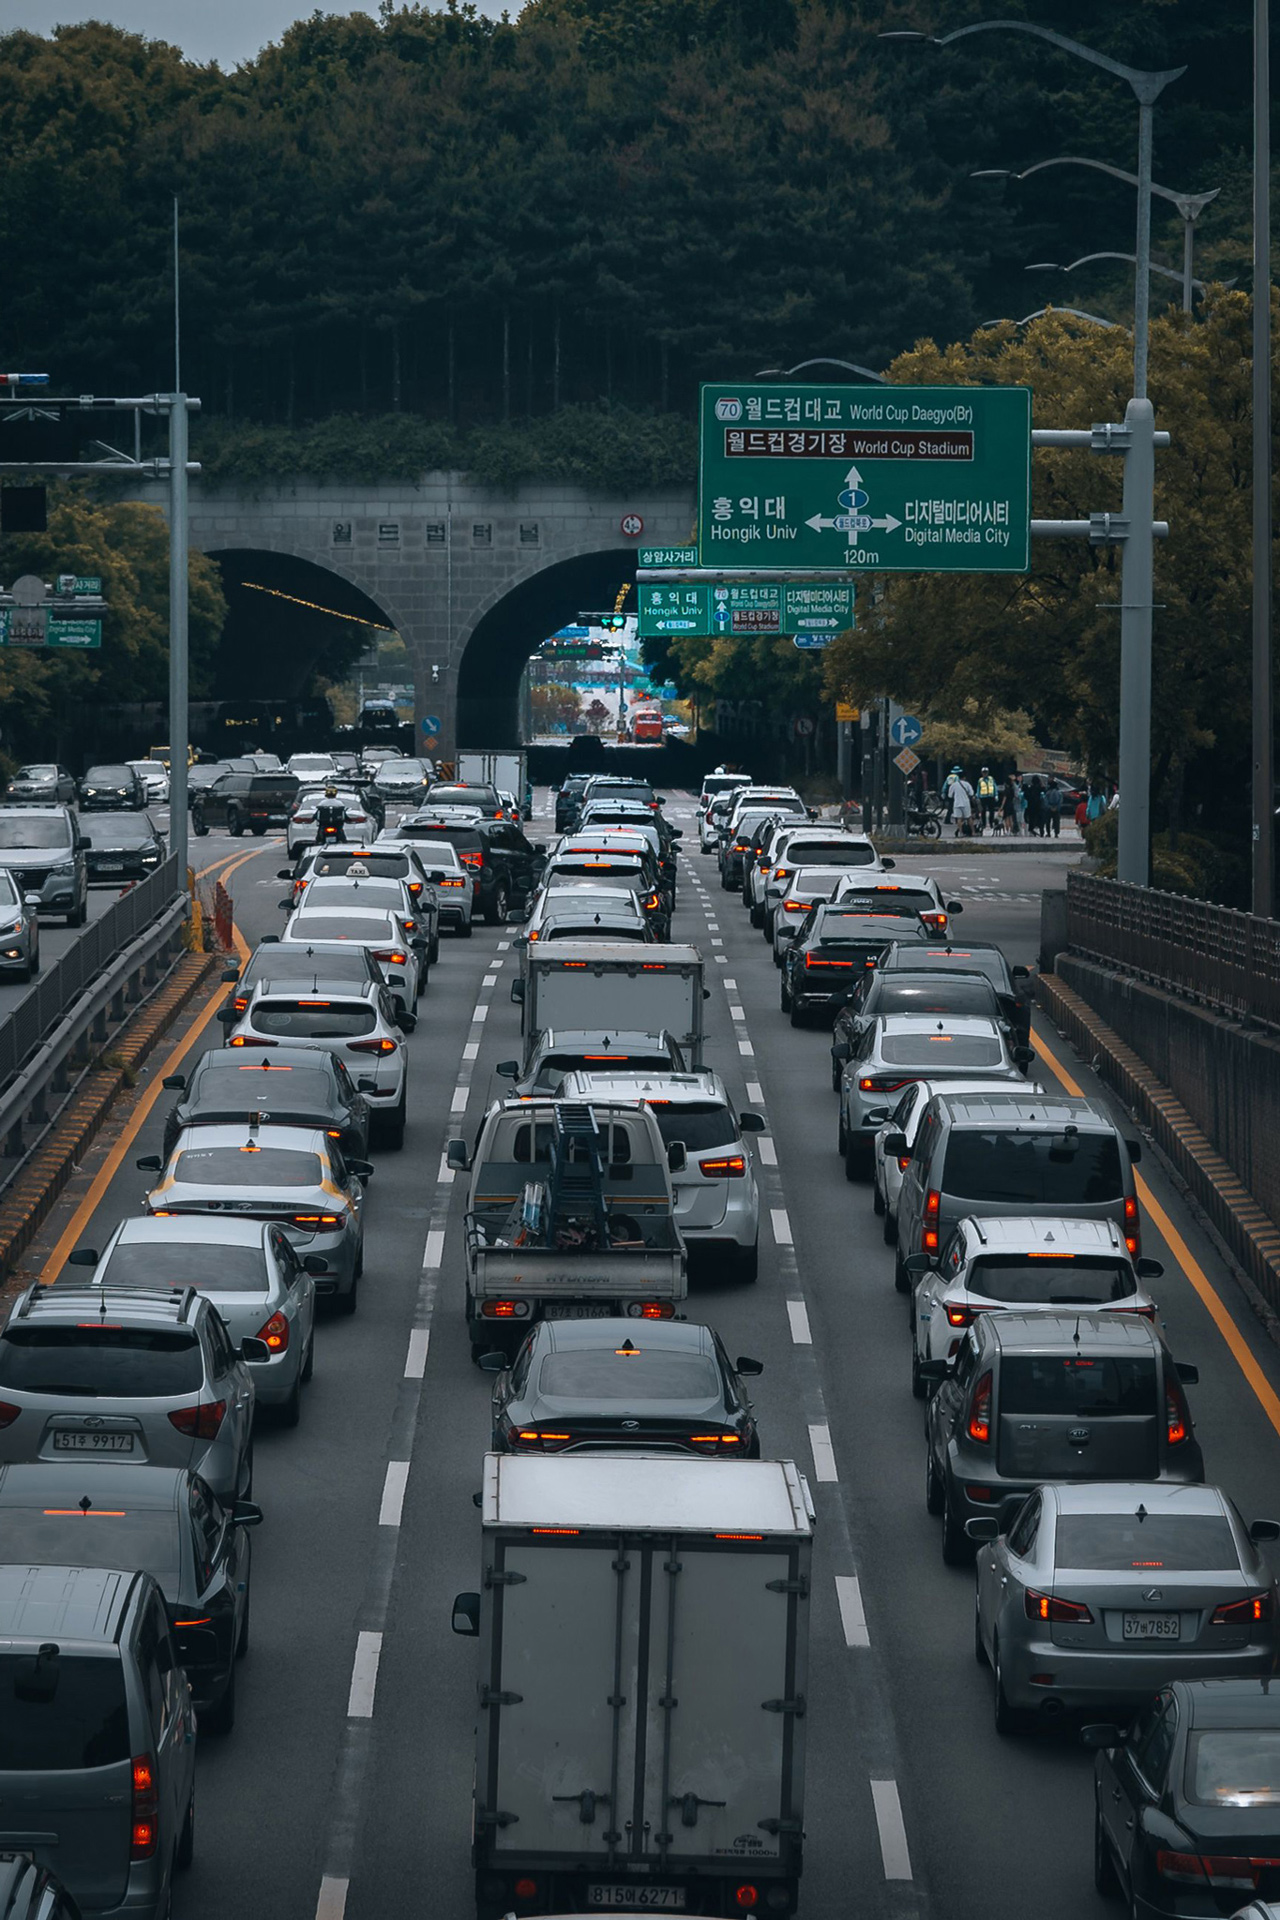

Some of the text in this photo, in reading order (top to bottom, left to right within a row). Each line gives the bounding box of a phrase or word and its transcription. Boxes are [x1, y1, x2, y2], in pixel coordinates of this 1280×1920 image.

[720, 403, 738, 417] 70
[745, 397, 842, 422] 월드컵대교
[850, 406, 973, 425] World Cup Daegyo(Br)
[727, 432, 847, 454] 월드컵경기장
[853, 440, 969, 457] World Cup Stadium
[849, 493, 857, 506] 1
[711, 496, 786, 520] 홍익대
[905, 500, 1009, 526] 디지털미디어시티
[332, 523, 539, 543] 월드컵터널
[711, 525, 797, 543] Hongik Univ
[905, 529, 1010, 546] Digital Media City
[642, 551, 694, 563] 상암사거리
[844, 550, 879, 564] 120m
[651, 591, 698, 605] 홍익대
[717, 590, 727, 598] 70
[730, 588, 779, 600] 월드컵대교
[787, 590, 849, 603] 디지털미디어시티
[644, 606, 703, 617] Hongik Univ
[733, 611, 779, 621] 월드컵경기장
[787, 604, 849, 615] Digital Media City
[577, 1307, 605, 1317] 0166
[62, 1434, 126, 1448] 51주 9917
